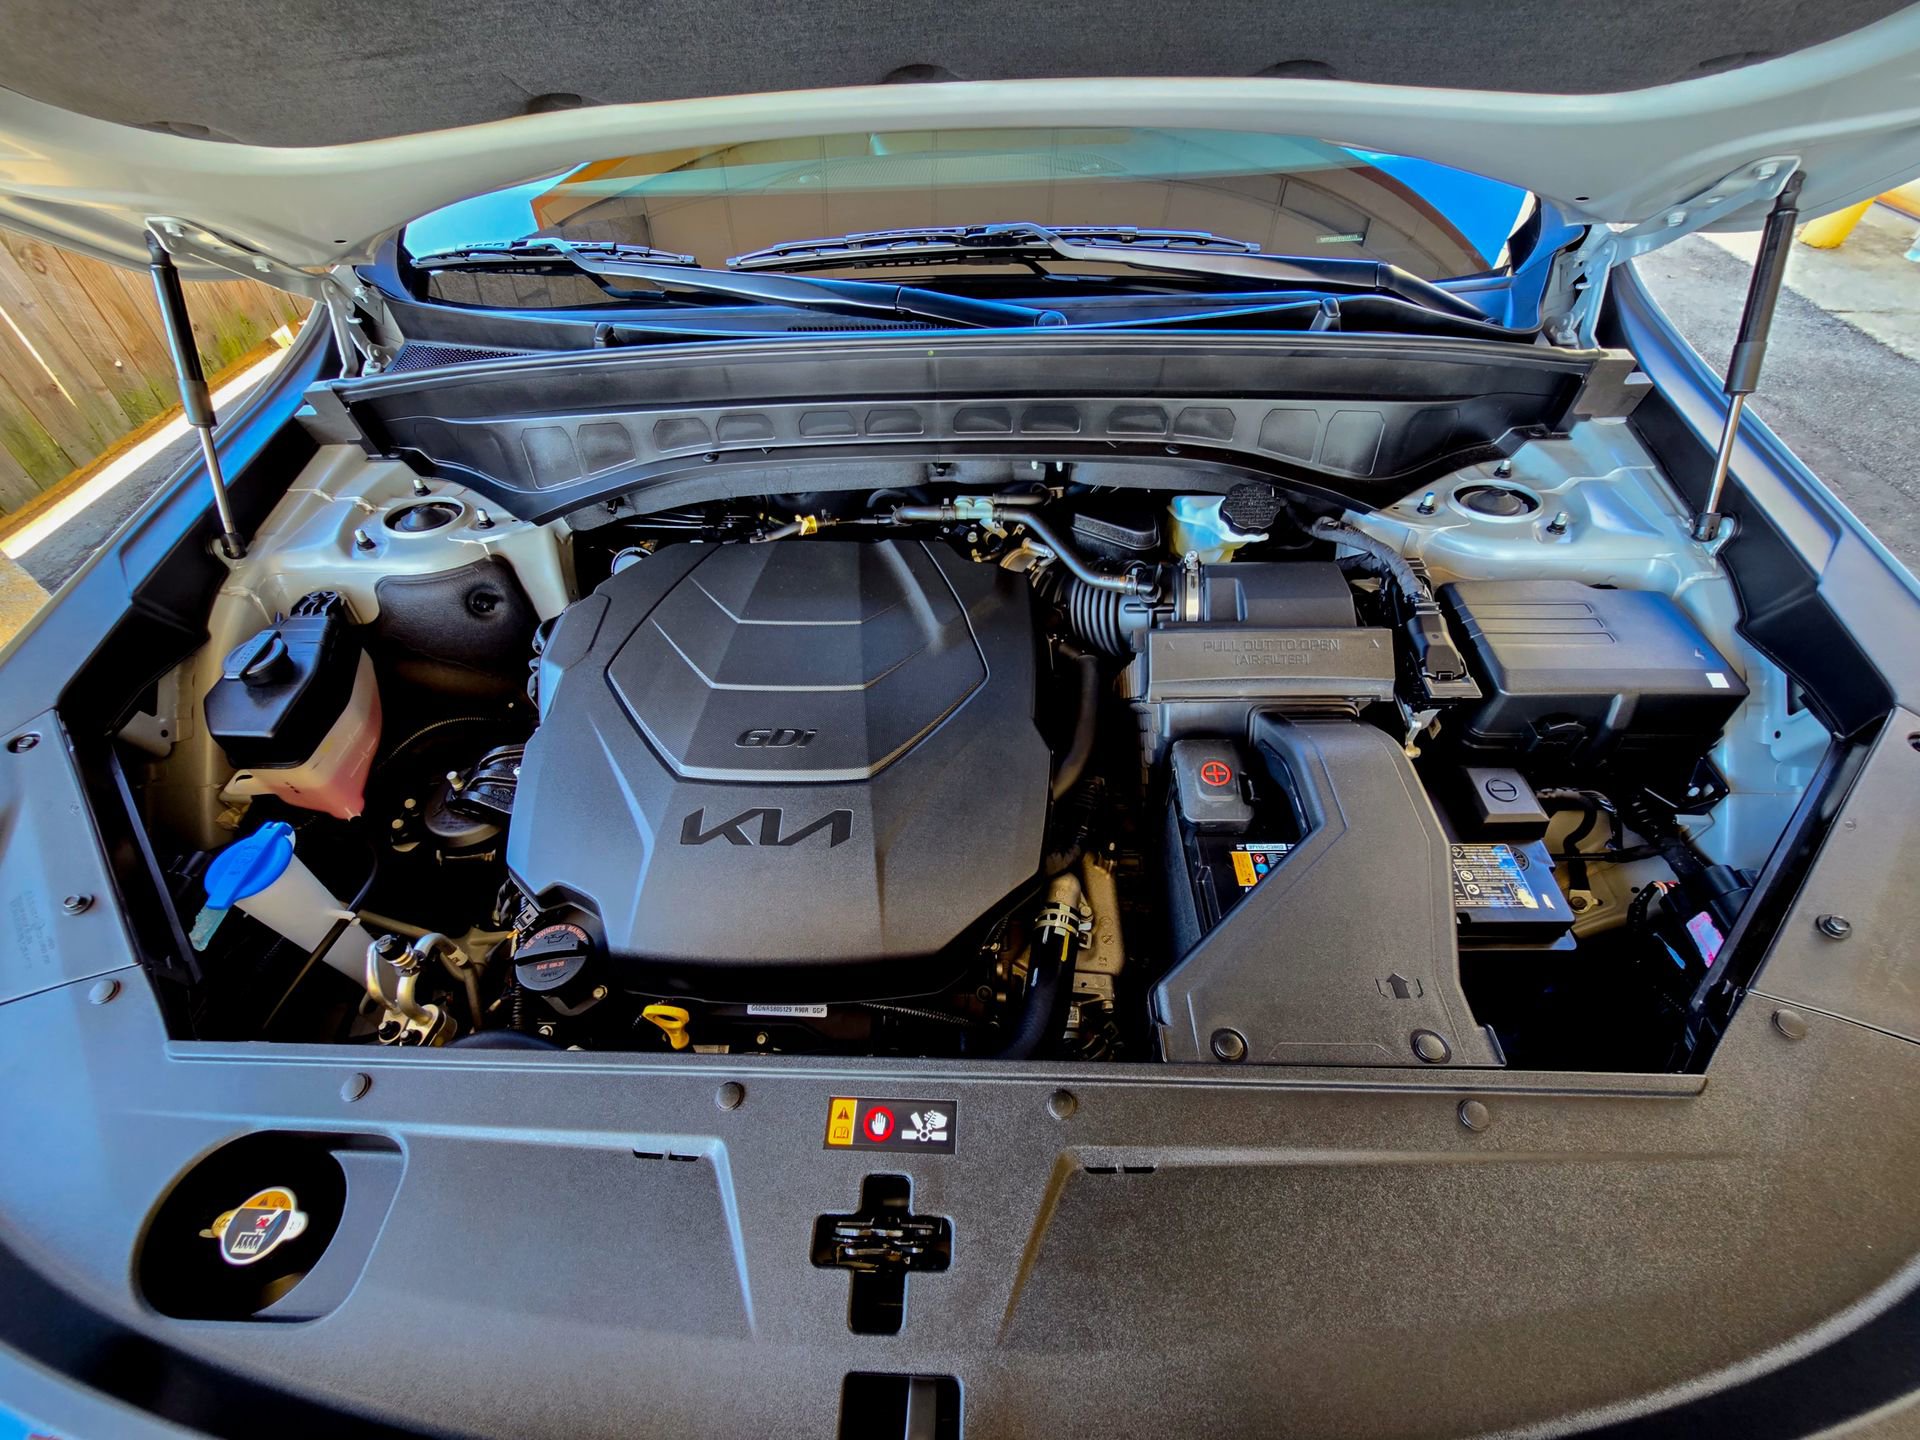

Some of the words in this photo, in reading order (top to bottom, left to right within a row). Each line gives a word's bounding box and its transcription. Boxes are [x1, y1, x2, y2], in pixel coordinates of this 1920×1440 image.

[1203, 640, 1240, 652] PULL
[1244, 640, 1273, 652] OUT
[1276, 640, 1297, 651] TO
[1300, 639, 1341, 651] OPEN
[735, 728, 817, 748] GDi
[680, 806, 854, 848] KIA
[536, 924, 566, 940] OWNER'S
